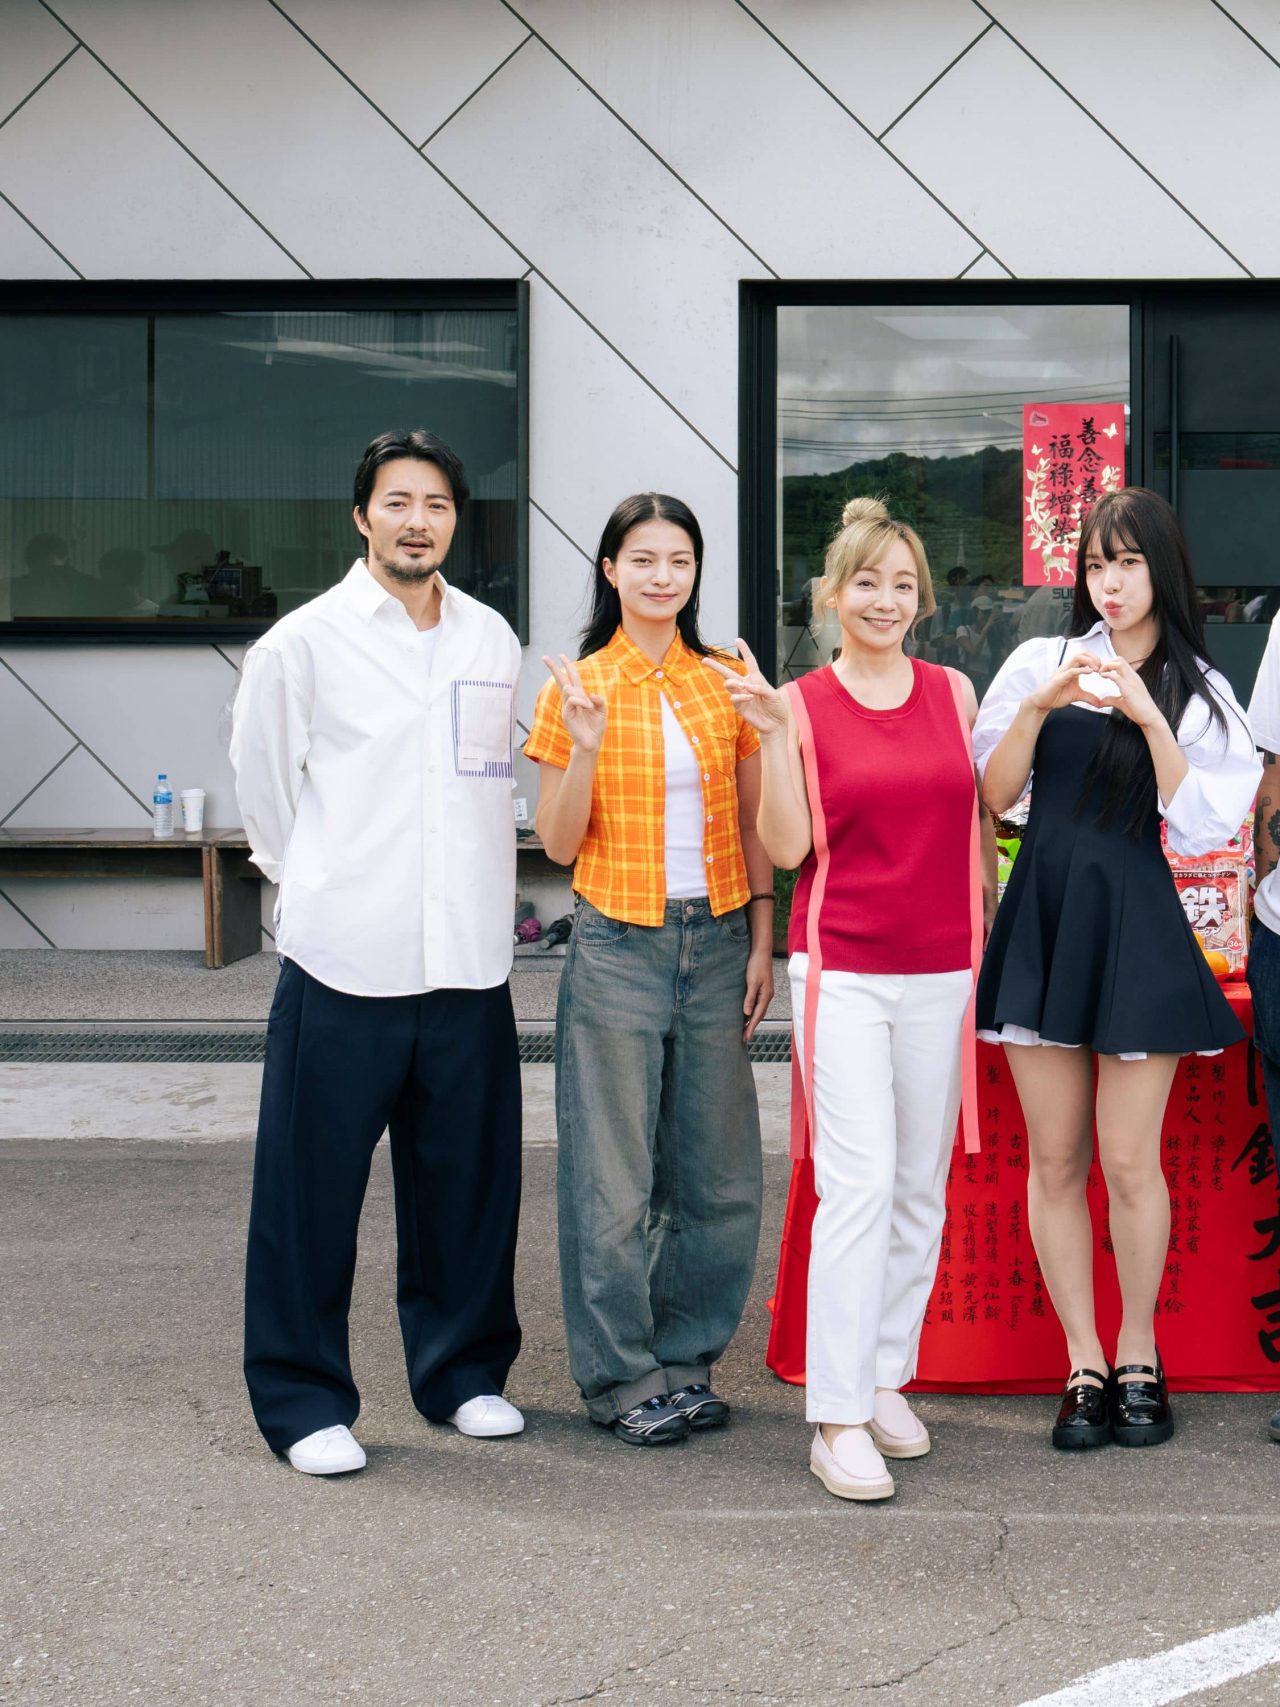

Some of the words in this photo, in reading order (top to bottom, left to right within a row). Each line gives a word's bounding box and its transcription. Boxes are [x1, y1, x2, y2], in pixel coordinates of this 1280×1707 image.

[1179, 886, 1226, 928] 鉄
[1184, 1061, 1203, 1125] 出品人
